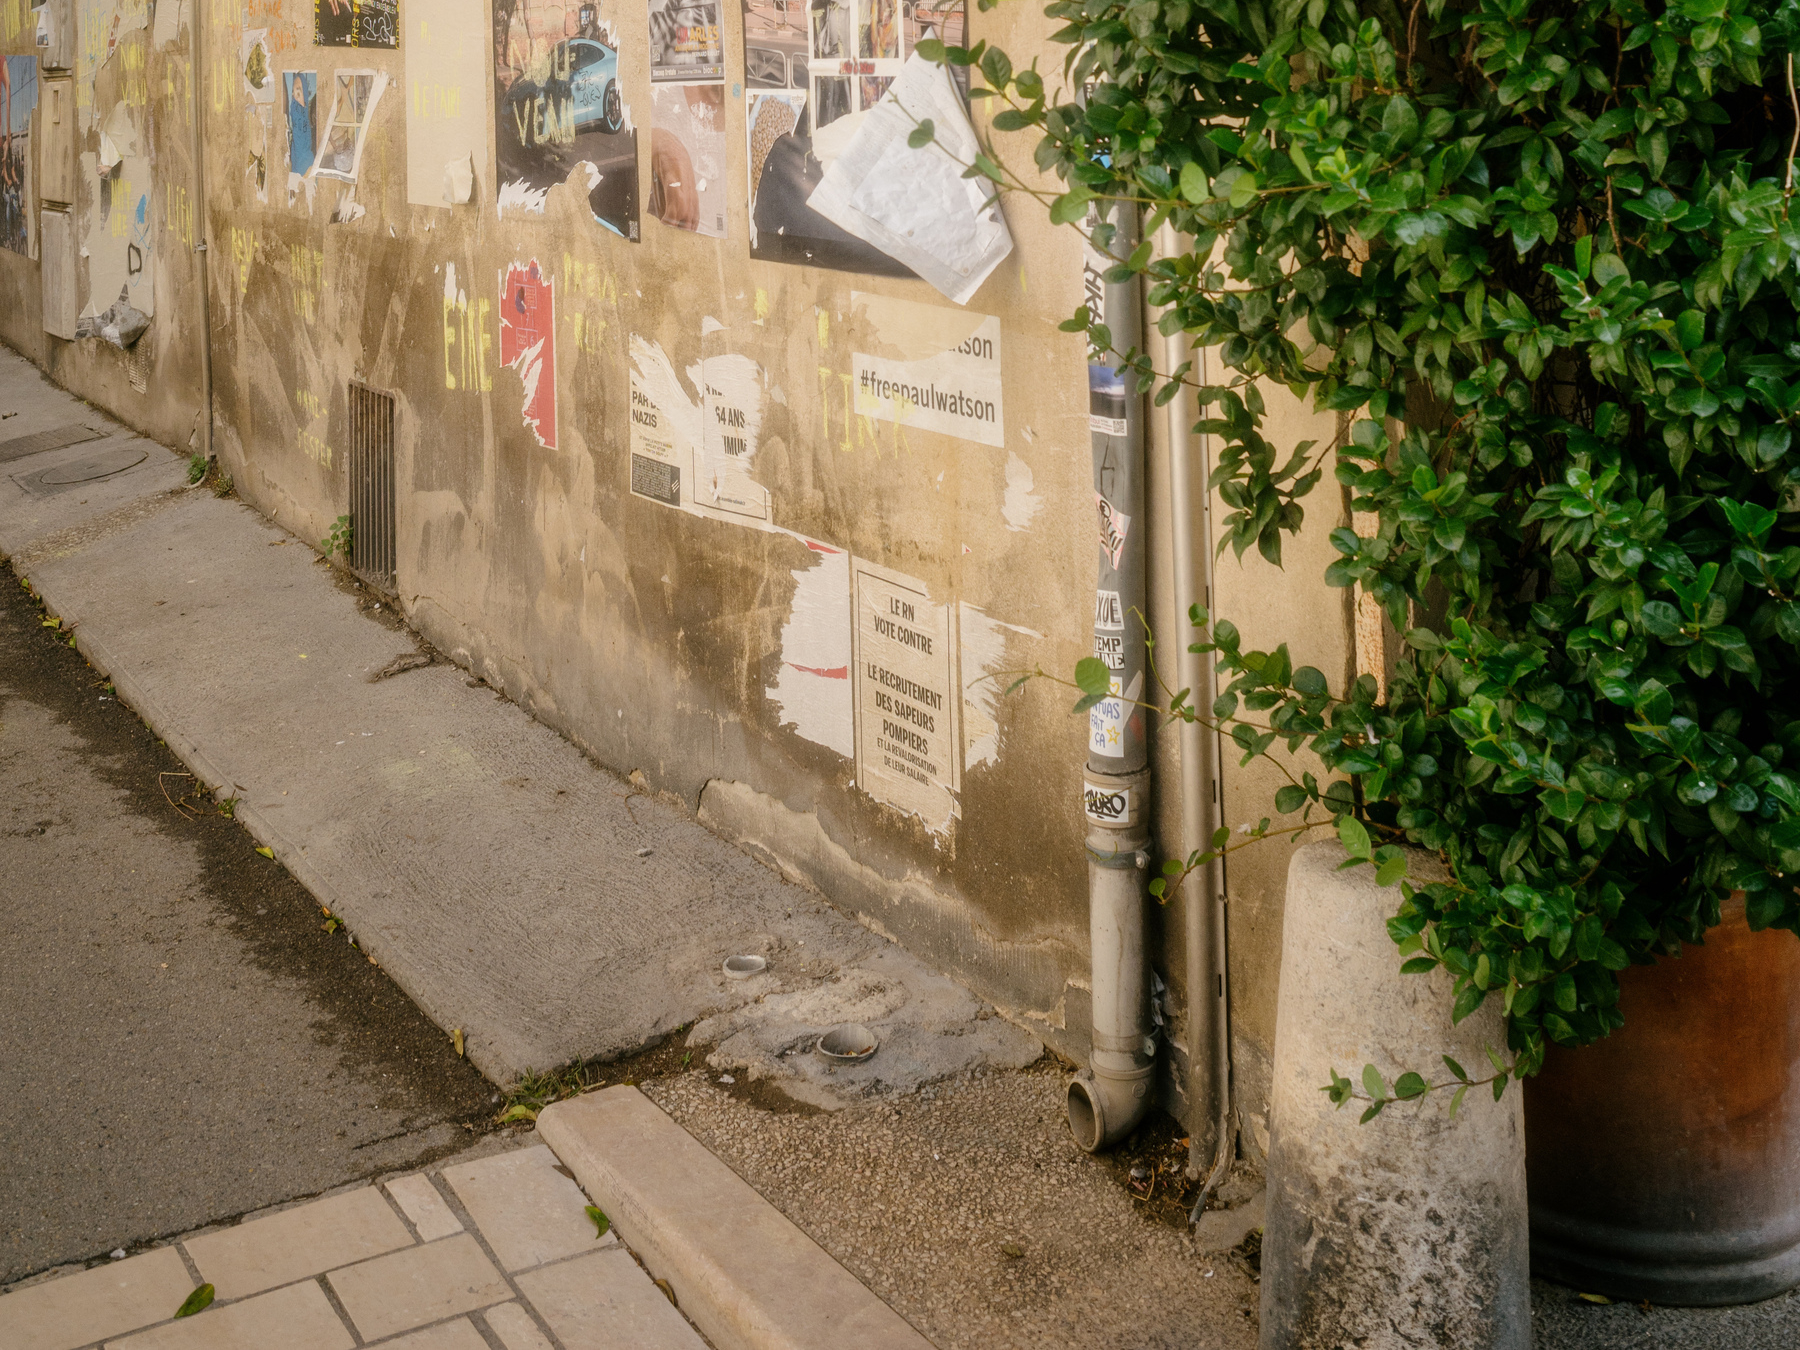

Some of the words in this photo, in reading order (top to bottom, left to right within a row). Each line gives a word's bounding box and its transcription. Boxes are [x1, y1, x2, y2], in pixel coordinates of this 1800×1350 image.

[690, 25, 720, 42] ARLES
[860, 369, 996, 424] #freepaulwatson
[632, 409, 658, 429] NAZIS
[728, 408, 746, 429] ANS
[891, 597, 900, 616] LE
[902, 602, 914, 623] RN
[874, 615, 896, 640] VOTE
[898, 626, 932, 656] CONTRE
[867, 662, 877, 681] LE
[880, 667, 942, 711] RECRUTEMENT
[876, 690, 892, 713] DES
[894, 699, 935, 733] SAPEURS
[883, 718, 928, 756] POMPIERS
[877, 737, 884, 748] ET
[884, 741, 891, 752] LA
[891, 744, 937, 776] REVALORISATION
[884, 755, 891, 768] DE
[892, 758, 906, 775] LEUR
[906, 767, 930, 787] SALAIRE
